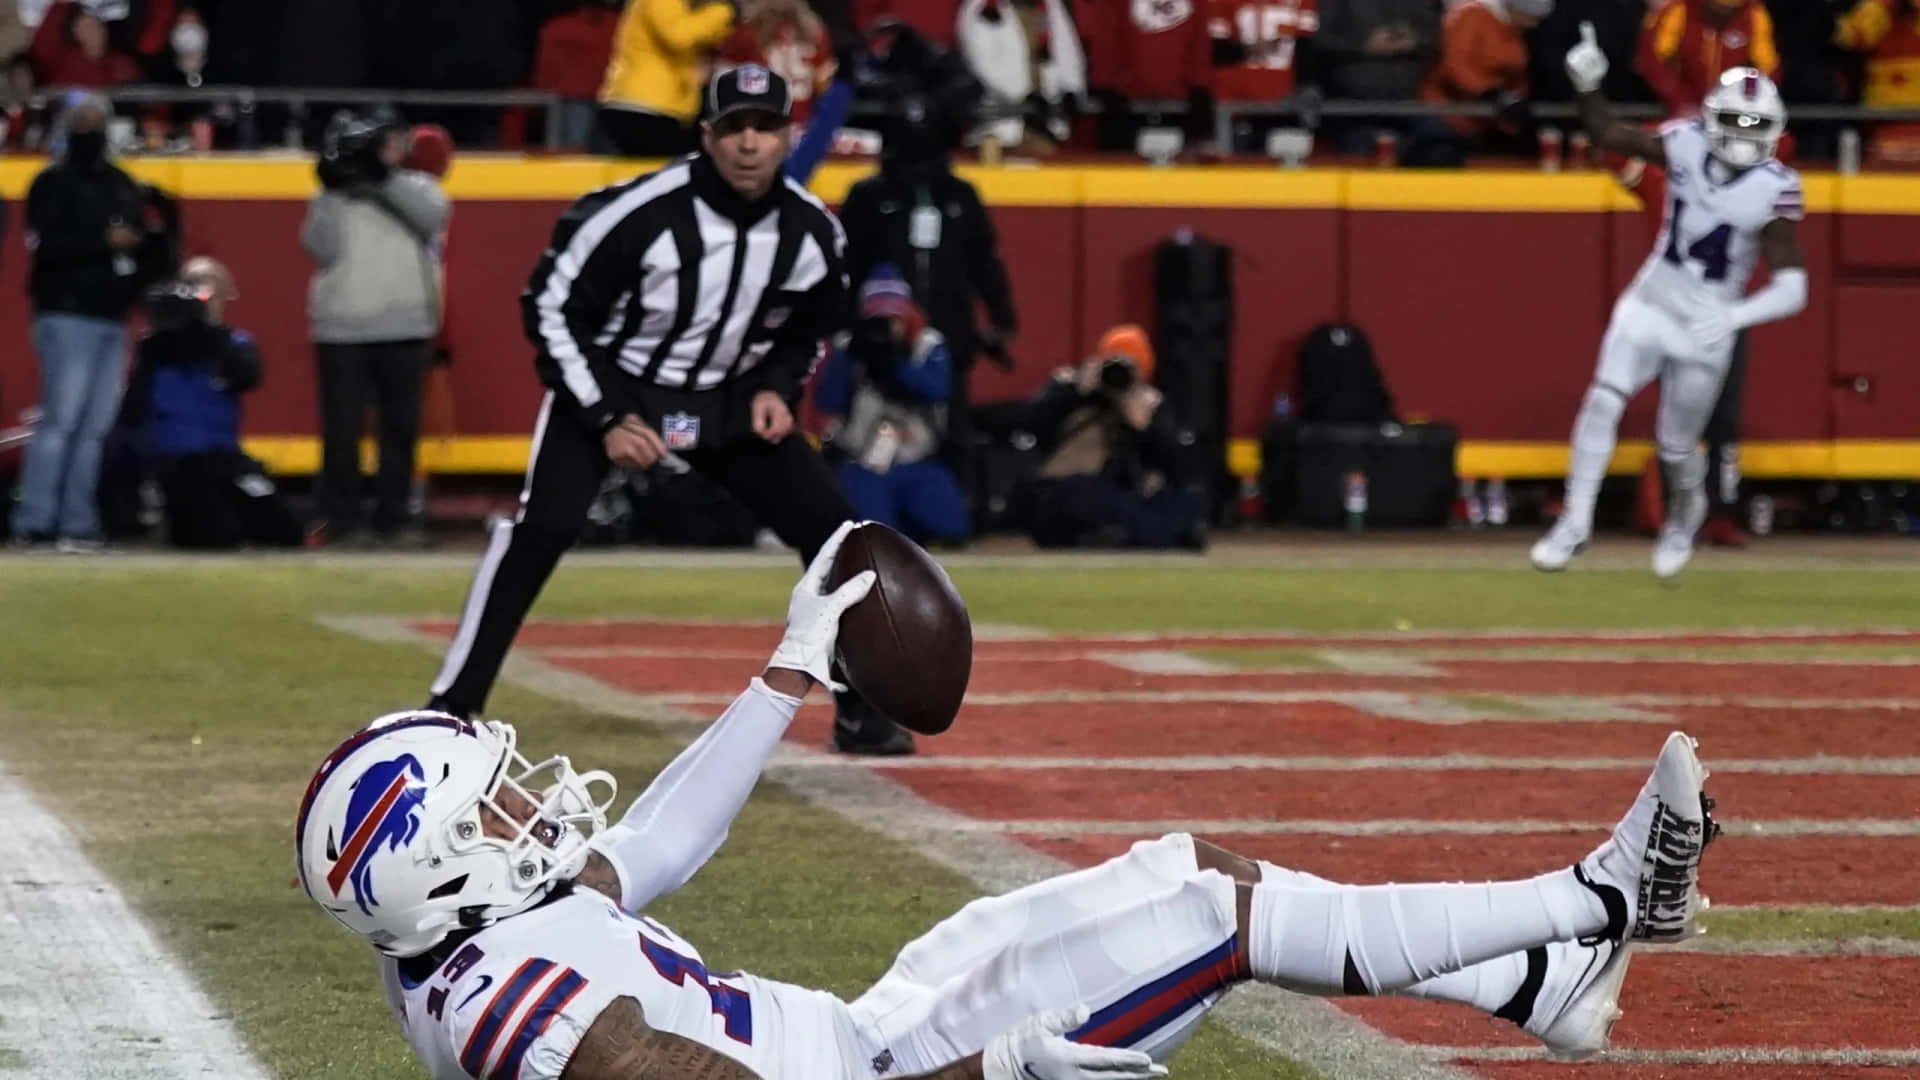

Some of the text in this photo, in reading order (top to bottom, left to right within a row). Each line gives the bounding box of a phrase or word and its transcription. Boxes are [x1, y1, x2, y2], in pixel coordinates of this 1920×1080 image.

[1236, 6, 1297, 70] 15
[1664, 198, 1734, 281] 14
[426, 943, 485, 1022] 13
